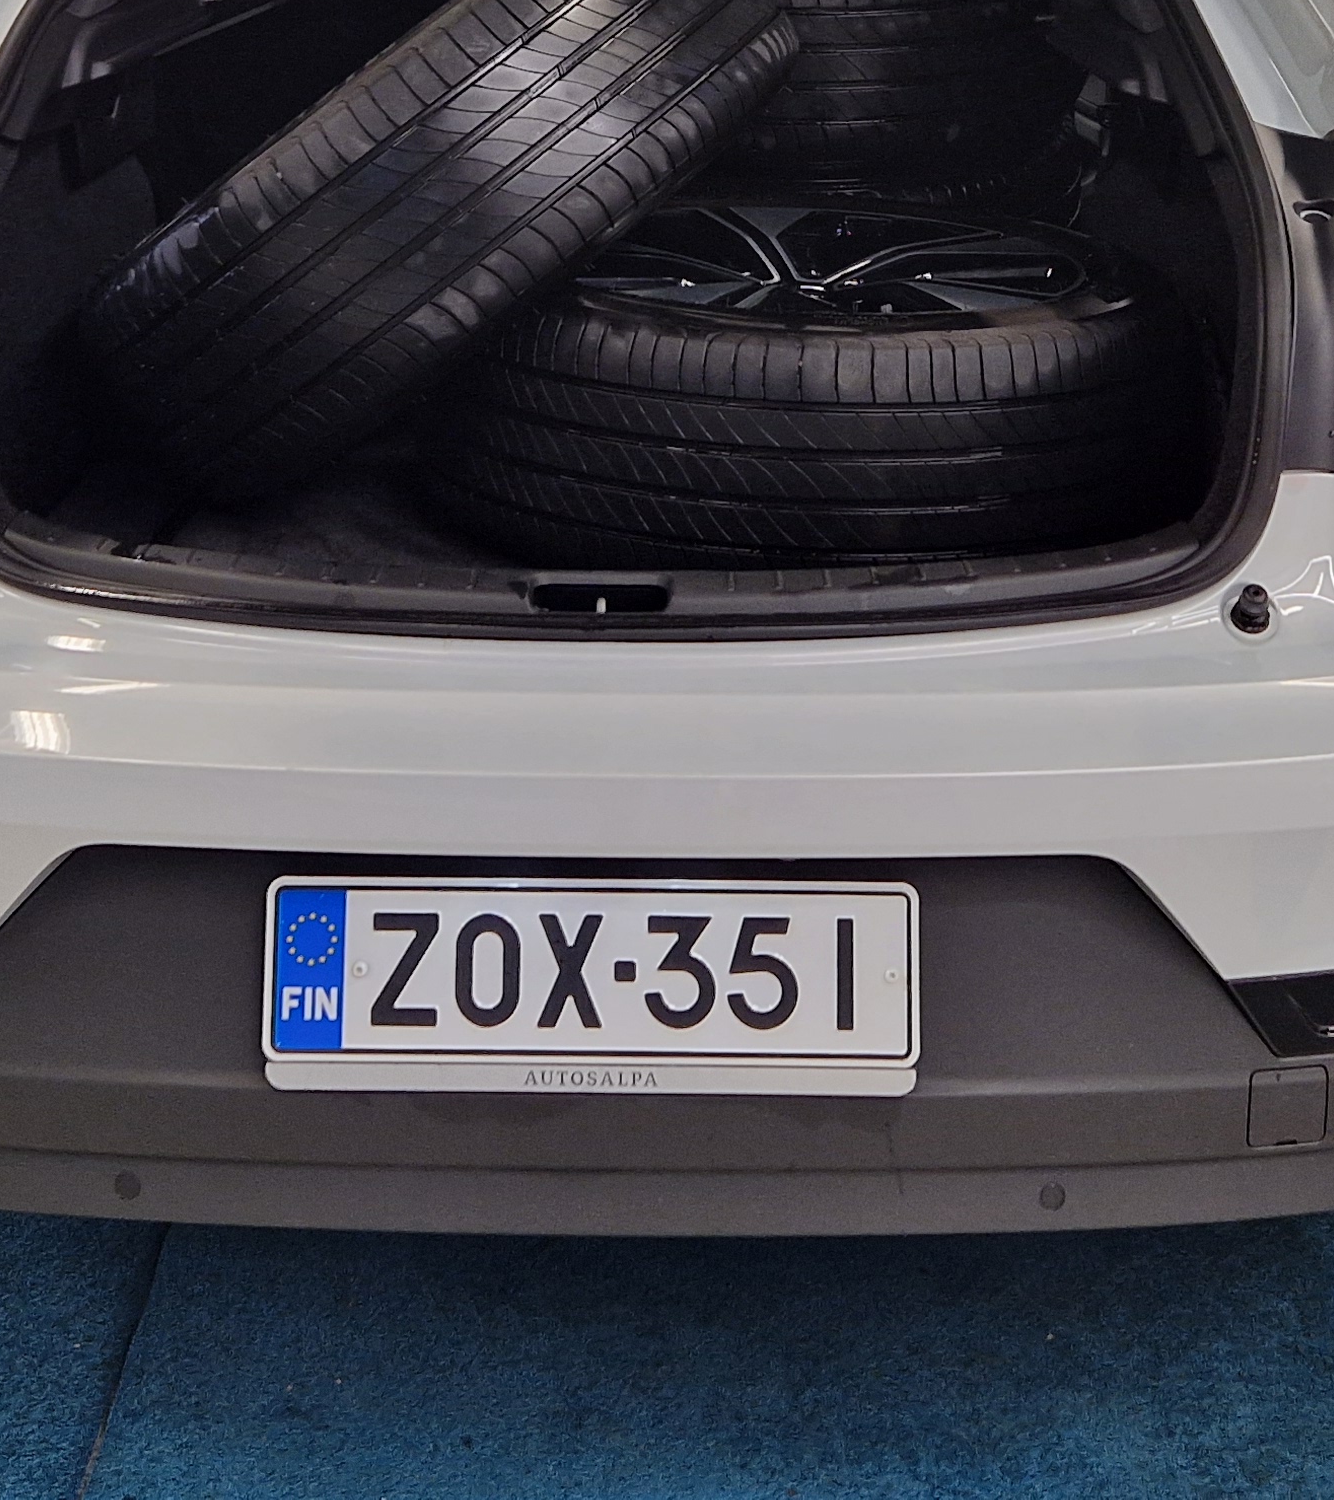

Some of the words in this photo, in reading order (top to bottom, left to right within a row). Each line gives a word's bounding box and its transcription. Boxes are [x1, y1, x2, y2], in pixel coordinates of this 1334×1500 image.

[280, 985, 339, 1023] FIN
[370, 911, 855, 1032] ZOX-351
[523, 1069, 659, 1088] AUTOSALPA
